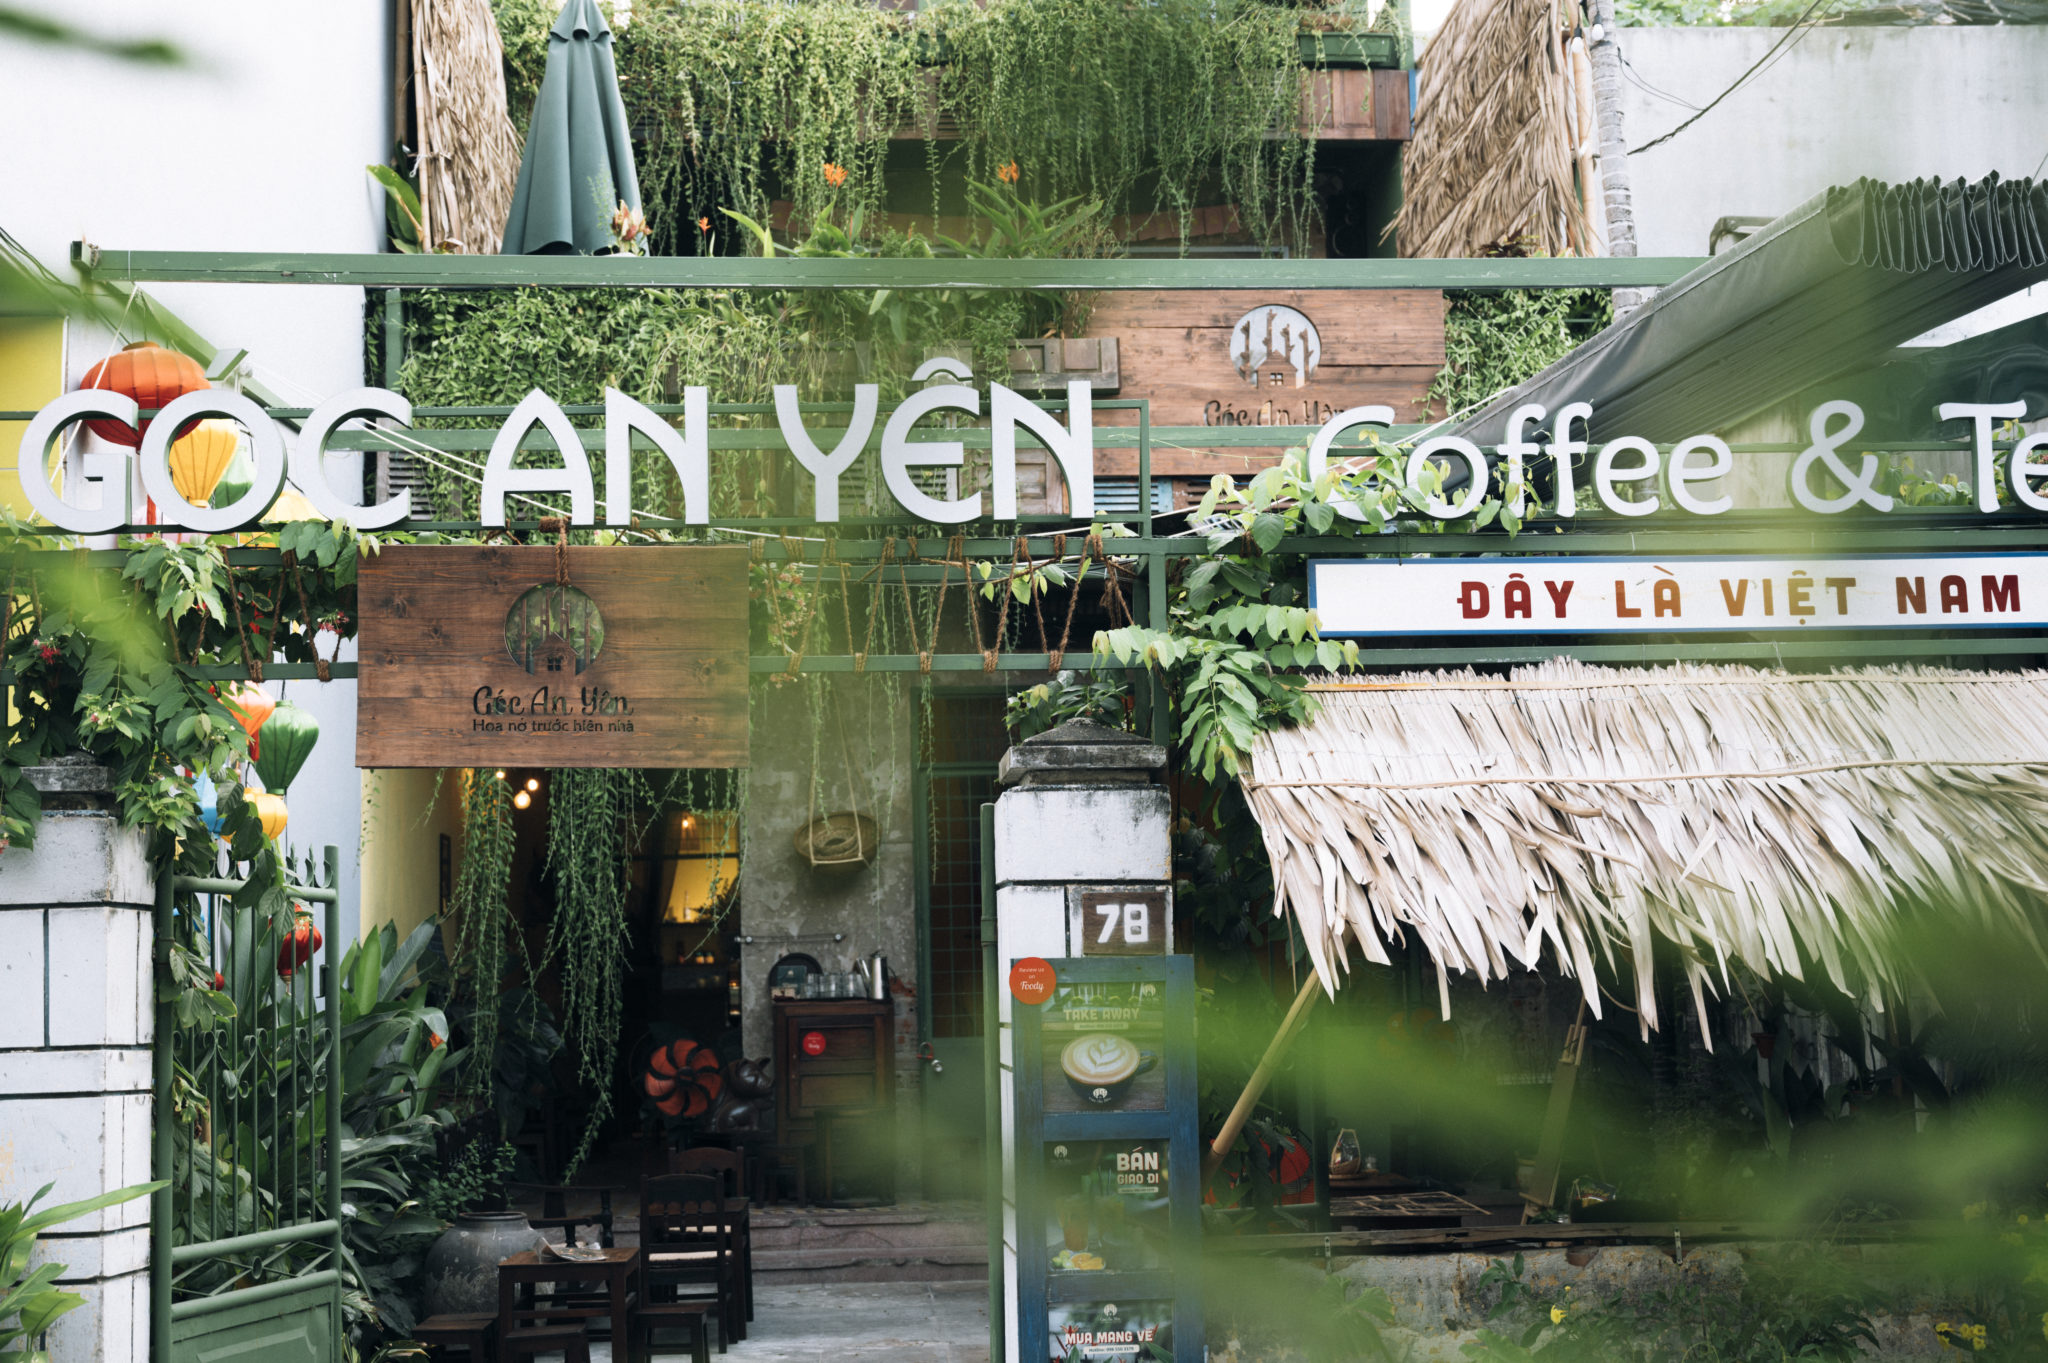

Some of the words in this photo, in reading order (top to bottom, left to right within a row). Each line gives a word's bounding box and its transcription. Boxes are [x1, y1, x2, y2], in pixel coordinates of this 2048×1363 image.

[480, 385, 710, 528] AN
[773, 356, 1095, 524] YÊN
[1307, 401, 1733, 522] Coffee
[1789, 399, 1894, 515] &
[1457, 572, 1575, 620] ĐÂY
[1614, 564, 1682, 618] LÀ
[1719, 569, 1857, 626] VIỆT
[1895, 574, 2022, 615] NAM
[473, 685, 525, 716] Góc
[530, 685, 573, 716] An
[580, 685, 635, 716] Yên
[472, 719, 503, 732] Hoa
[532, 718, 569, 732] trước
[573, 719, 603, 732] hiên
[1096, 903, 1149, 943] 78
[1020, 980, 1044, 993] Foody
[1063, 1008, 1098, 1021] TAKE
[1102, 1007, 1140, 1020] AWAY
[1116, 1146, 1159, 1172] BÁN
[1117, 1173, 1145, 1186] GIAO
[1065, 1332, 1094, 1345] MUA
[1096, 1330, 1134, 1344] MANG
